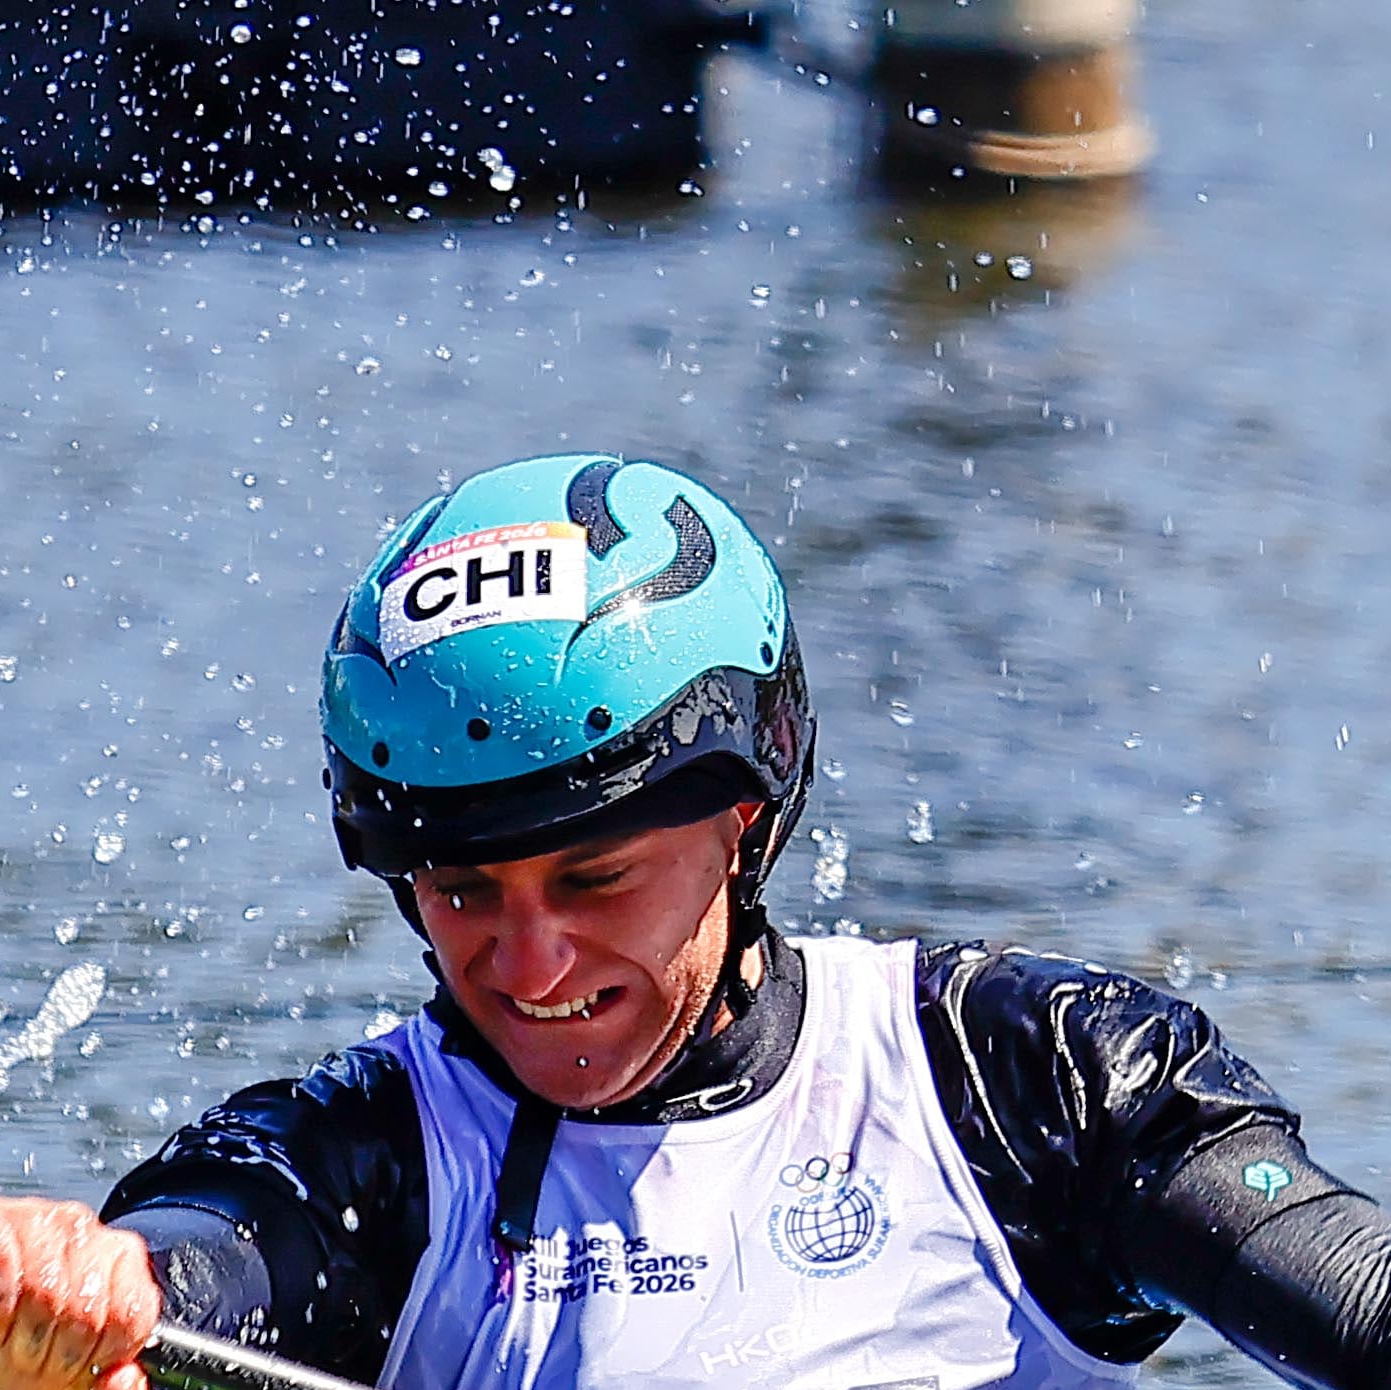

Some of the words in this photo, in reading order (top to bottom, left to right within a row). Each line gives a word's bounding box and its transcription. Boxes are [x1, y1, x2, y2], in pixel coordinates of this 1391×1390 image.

[473, 532, 495, 546] FE
[403, 549, 553, 623] CHI
[566, 1235, 650, 1261] Juegos
[524, 1253, 709, 1281] Suramericanos
[524, 1280, 588, 1304] Santa
[593, 1273, 624, 1295] Fe
[630, 1272, 696, 1296] 2026
